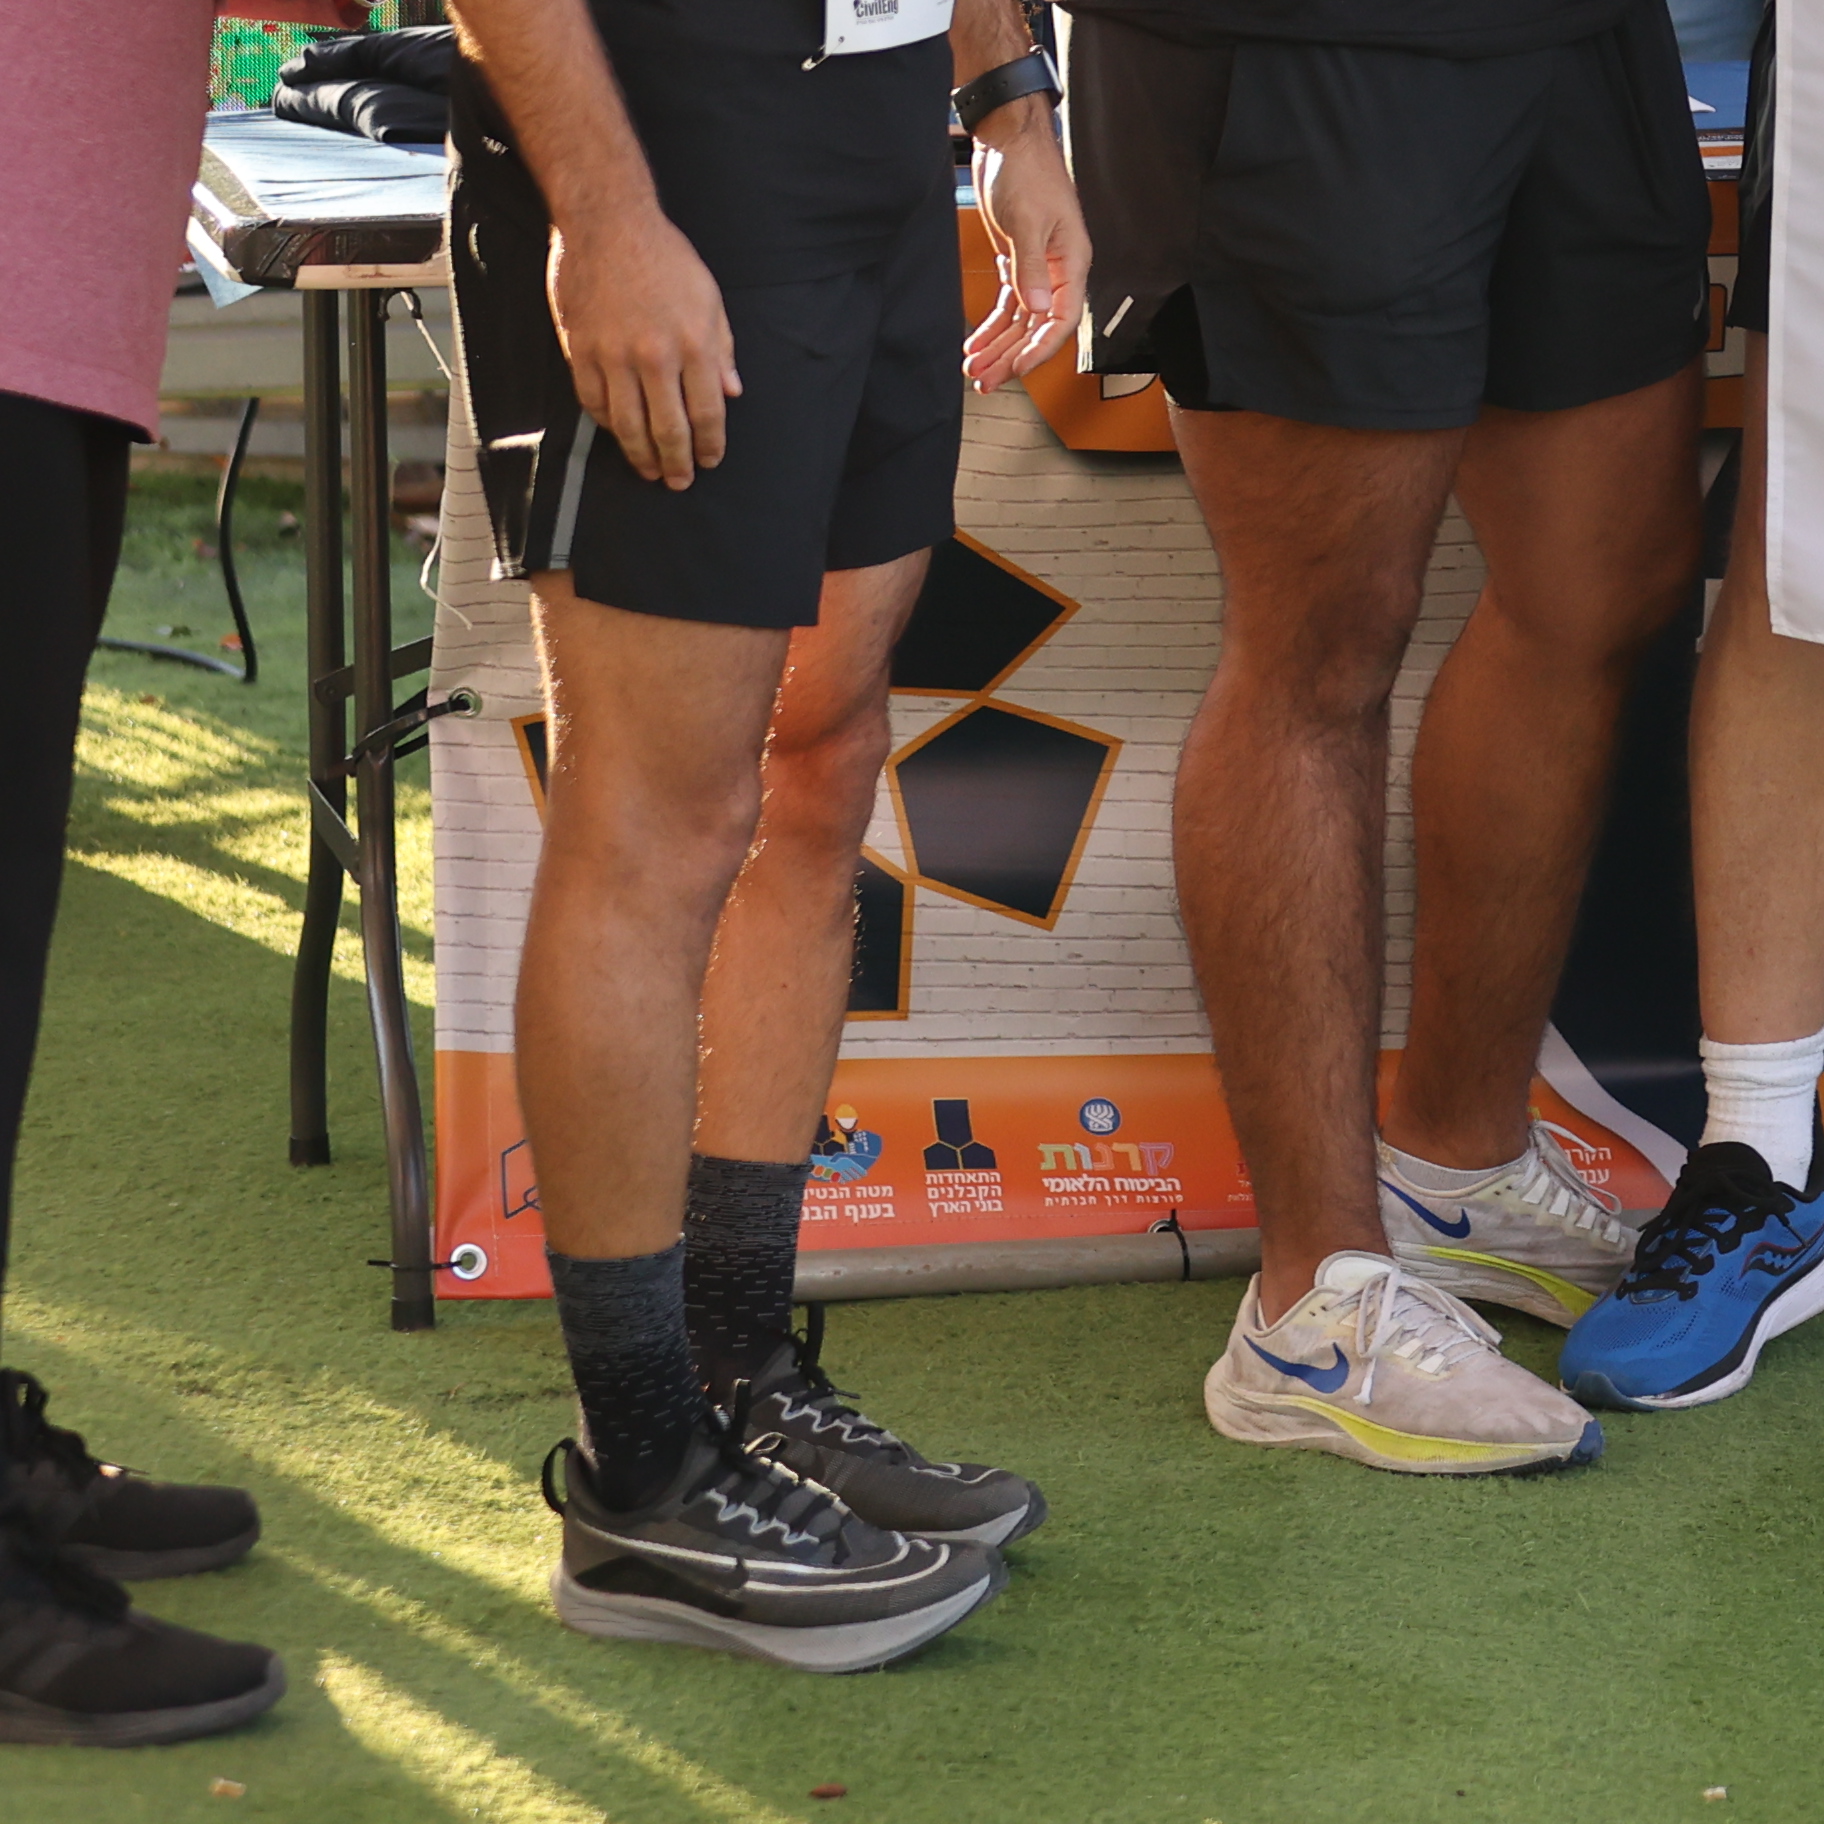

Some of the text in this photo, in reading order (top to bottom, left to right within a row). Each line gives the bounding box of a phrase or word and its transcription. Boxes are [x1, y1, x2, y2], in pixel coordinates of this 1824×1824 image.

[1037, 1141, 1175, 1178] קרנות
[925, 1171, 1002, 1185] התאחדות
[1041, 1175, 1182, 1194] הביטוח הלאומי
[803, 1185, 894, 1200] מטה הבטי
[926, 1184, 1003, 1200] הקבלנים
[1104, 1194, 1131, 1207] דרך
[843, 1203, 895, 1221] בענף
[930, 1199, 1004, 1218] בוני הארץ
